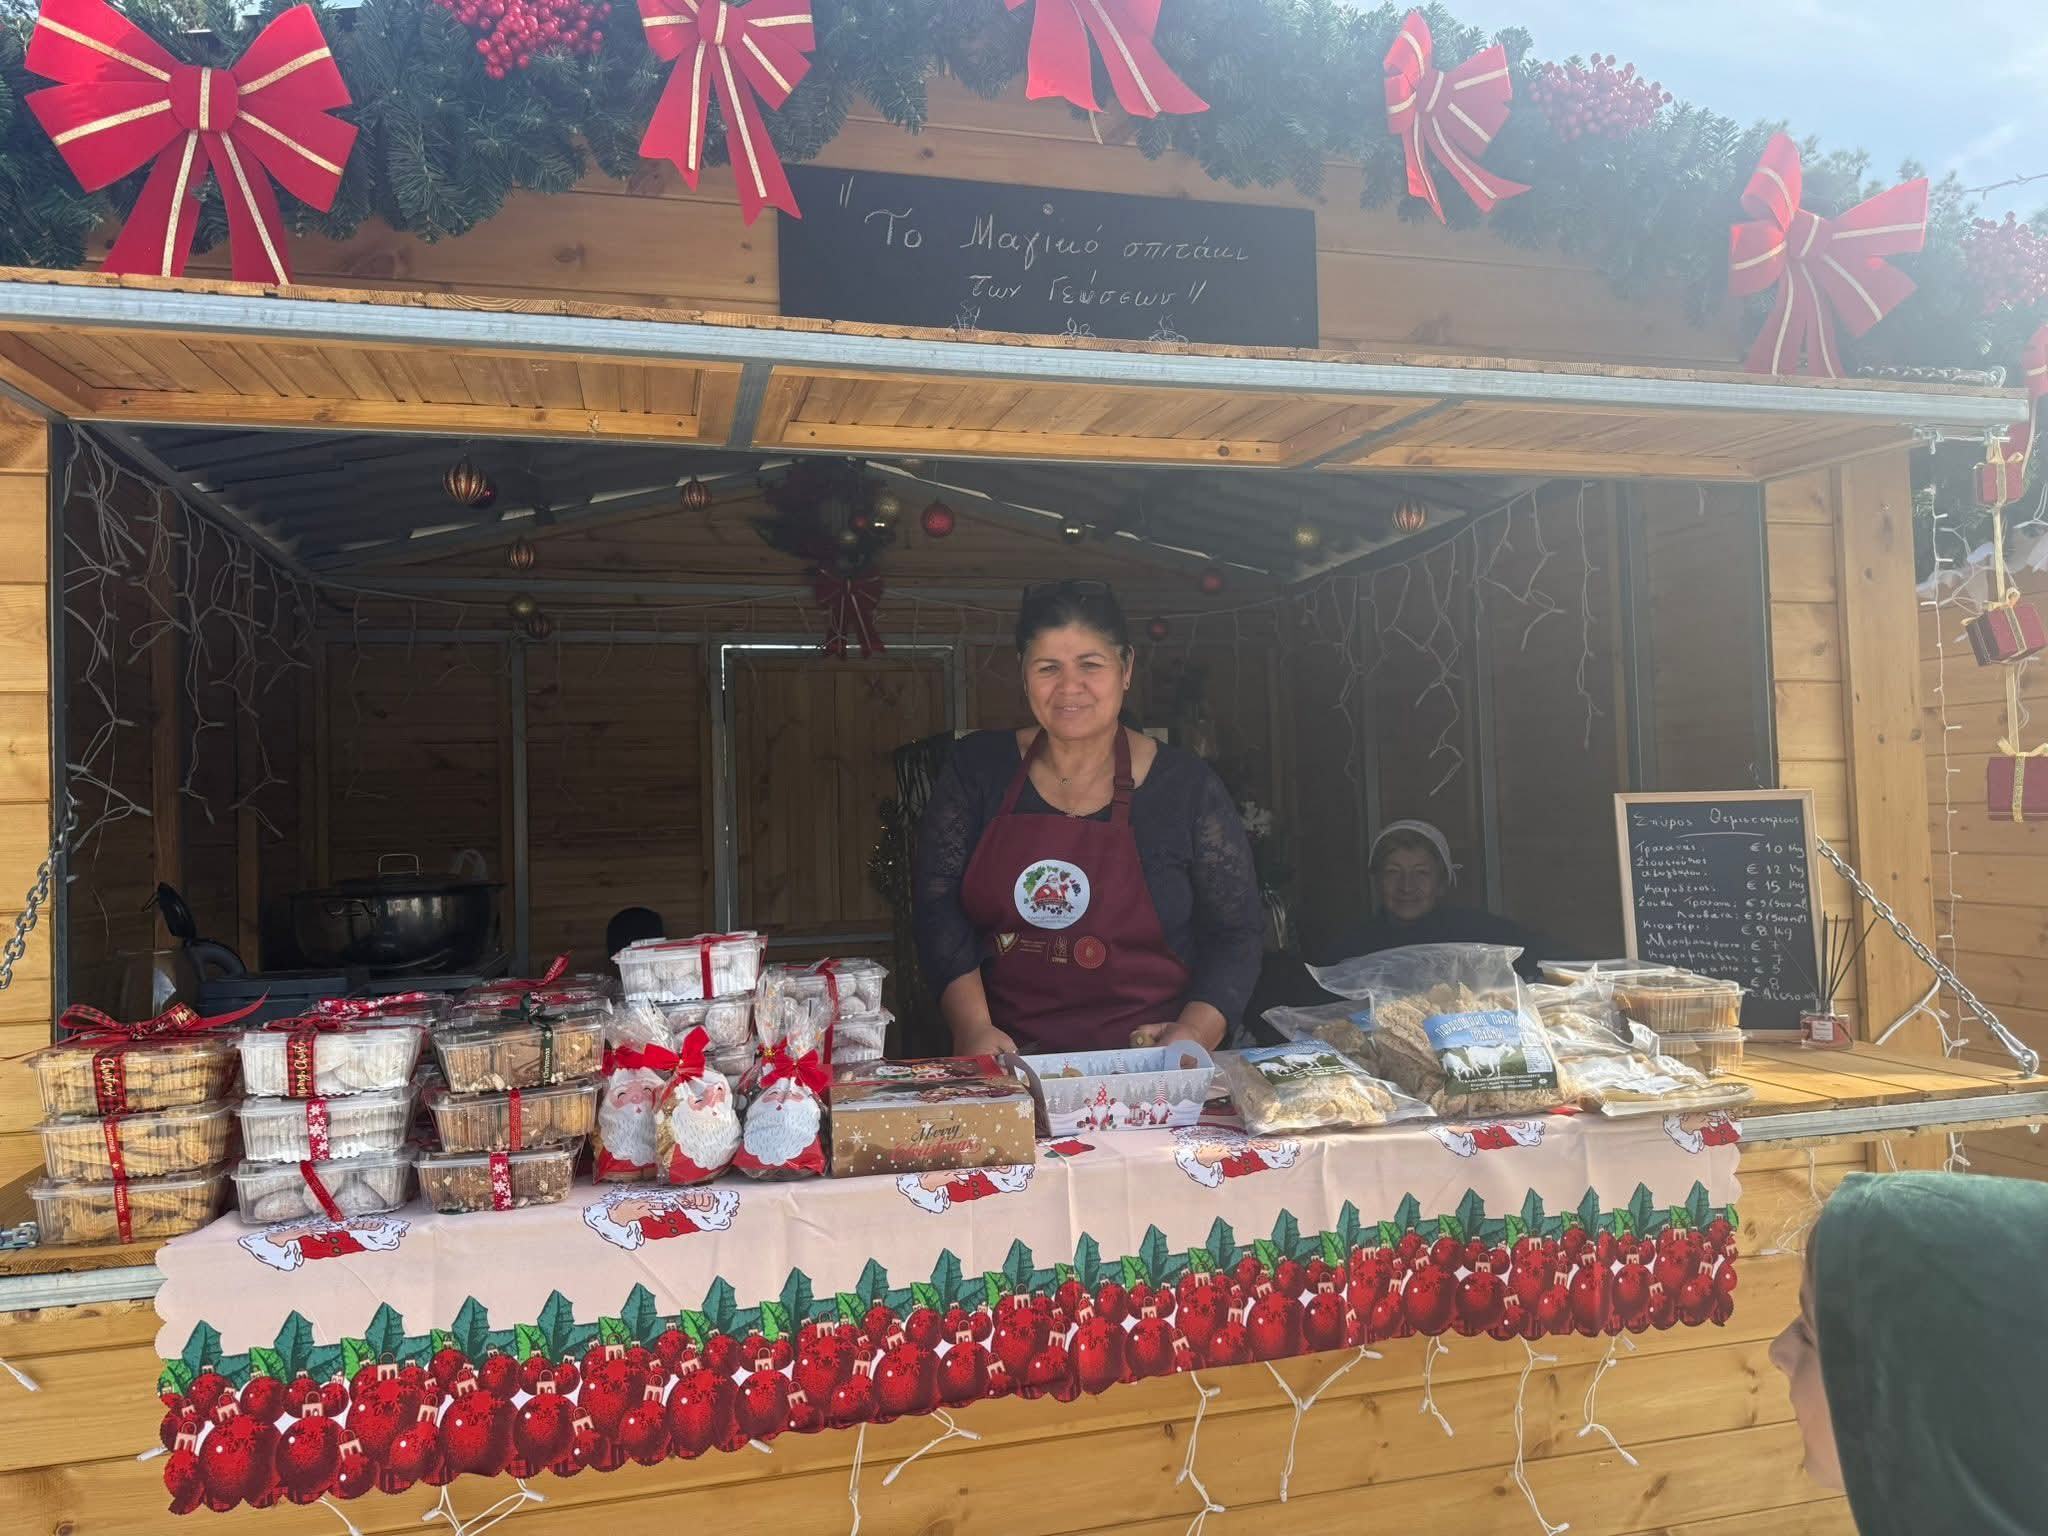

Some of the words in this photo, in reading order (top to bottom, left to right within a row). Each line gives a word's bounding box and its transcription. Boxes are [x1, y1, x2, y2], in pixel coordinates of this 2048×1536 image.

[960, 213, 1103, 271] Μαγικό
[1750, 843, 1760, 852] €
[1764, 842, 1783, 854] 10
[1746, 864, 1759, 875] €
[1766, 864, 1782, 875] 12
[1746, 880, 1757, 891] €
[1764, 881, 1781, 894] 15
[1755, 925, 1768, 936] 8
[911, 1123, 964, 1142] Merry
